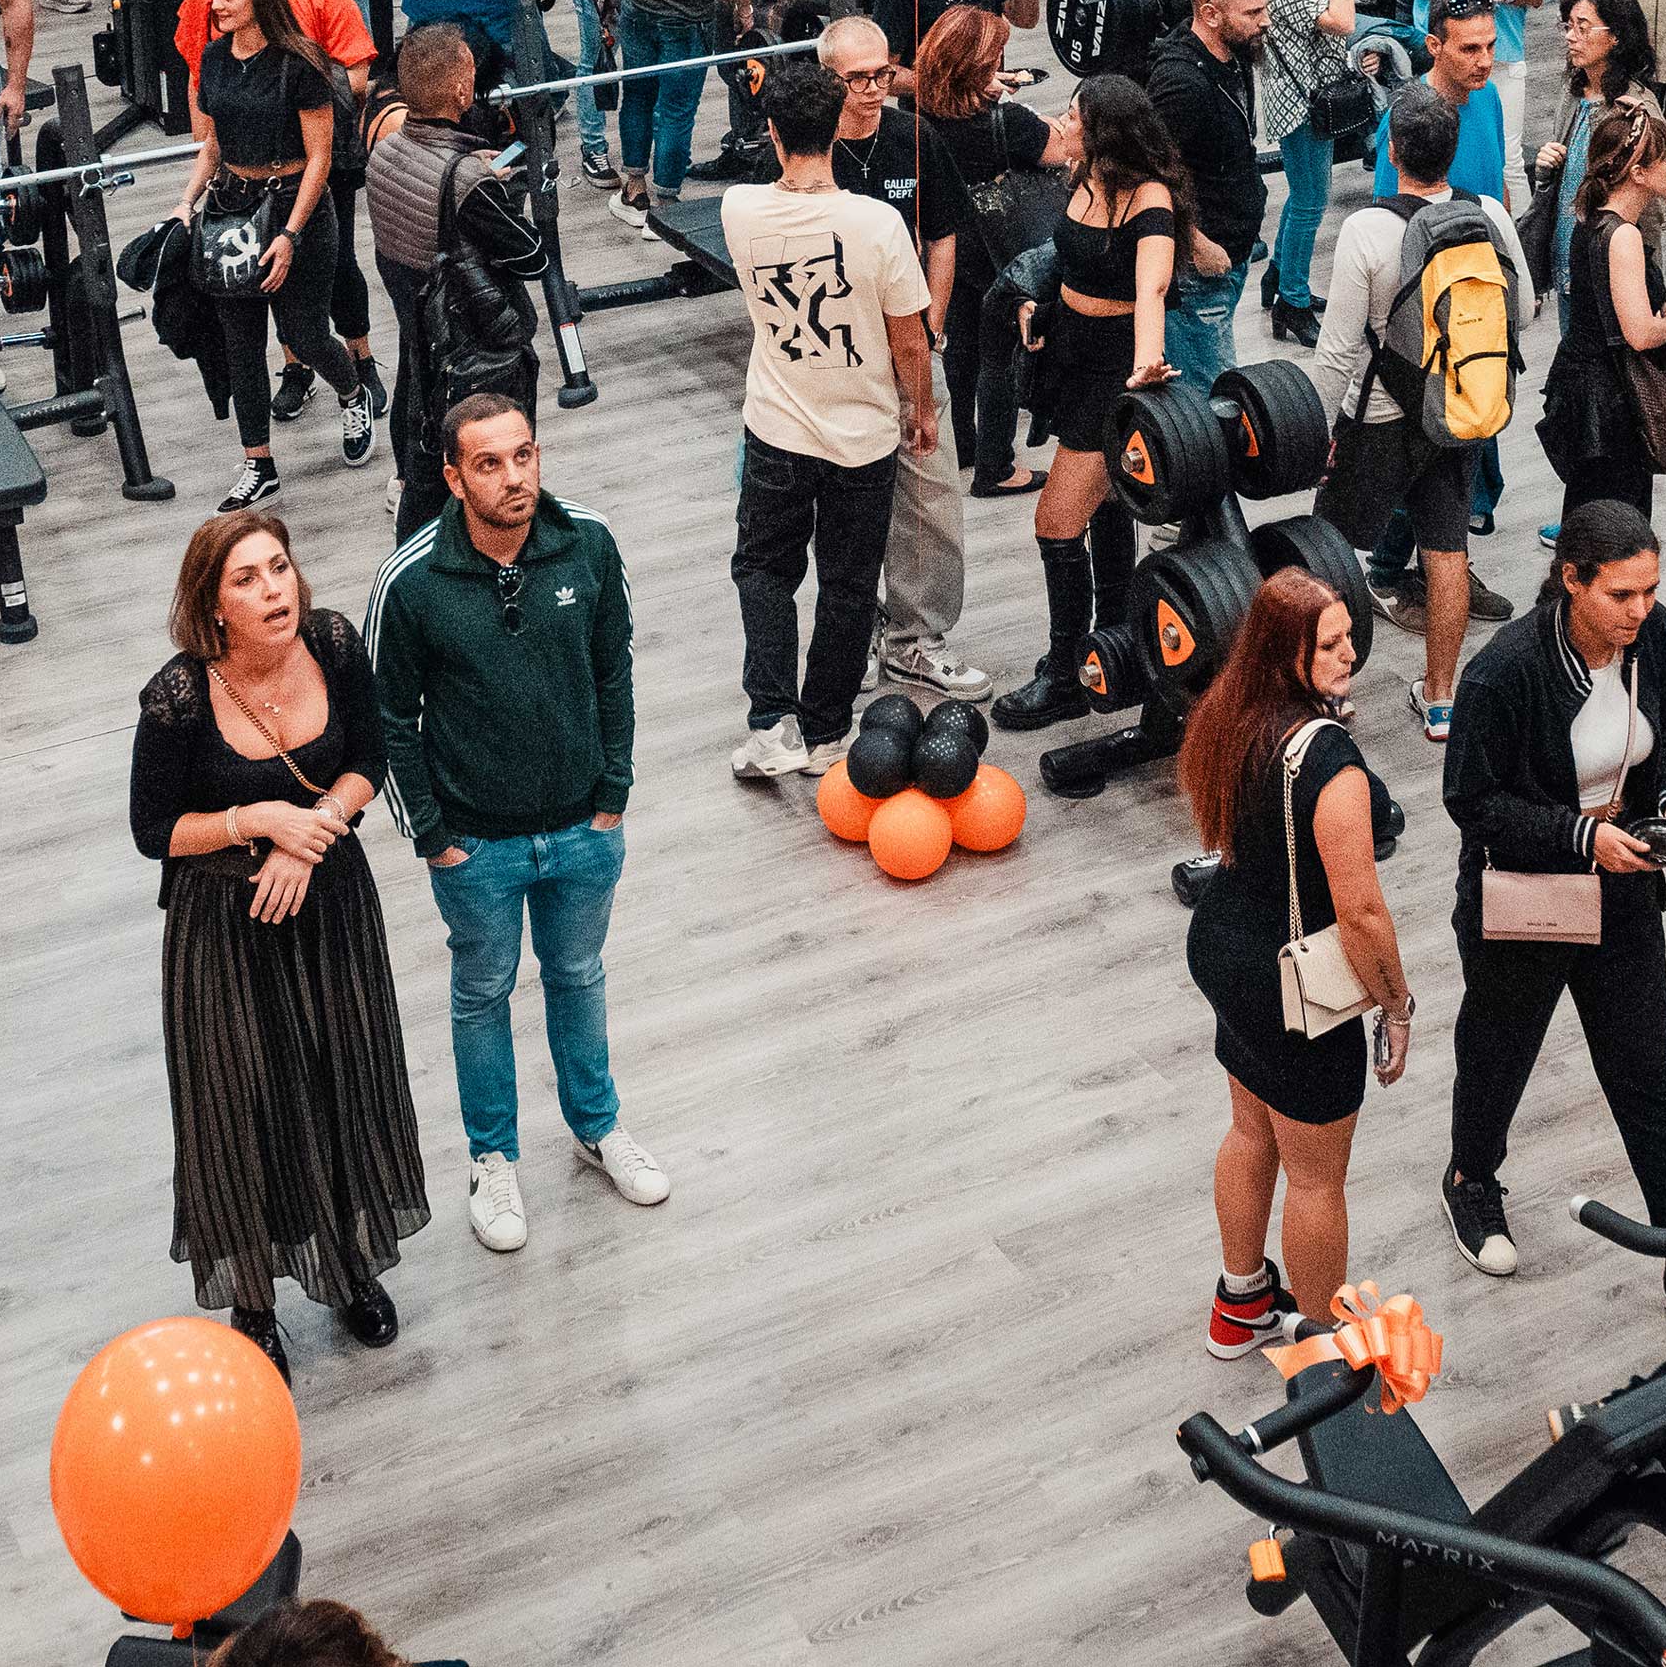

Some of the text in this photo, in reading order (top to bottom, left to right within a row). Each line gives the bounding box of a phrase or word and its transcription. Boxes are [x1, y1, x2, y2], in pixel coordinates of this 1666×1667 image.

[598, 287, 643, 301] MATRIX
[20, 398, 77, 418] MATRIX
[1375, 1530, 1496, 1575] MATRIX
